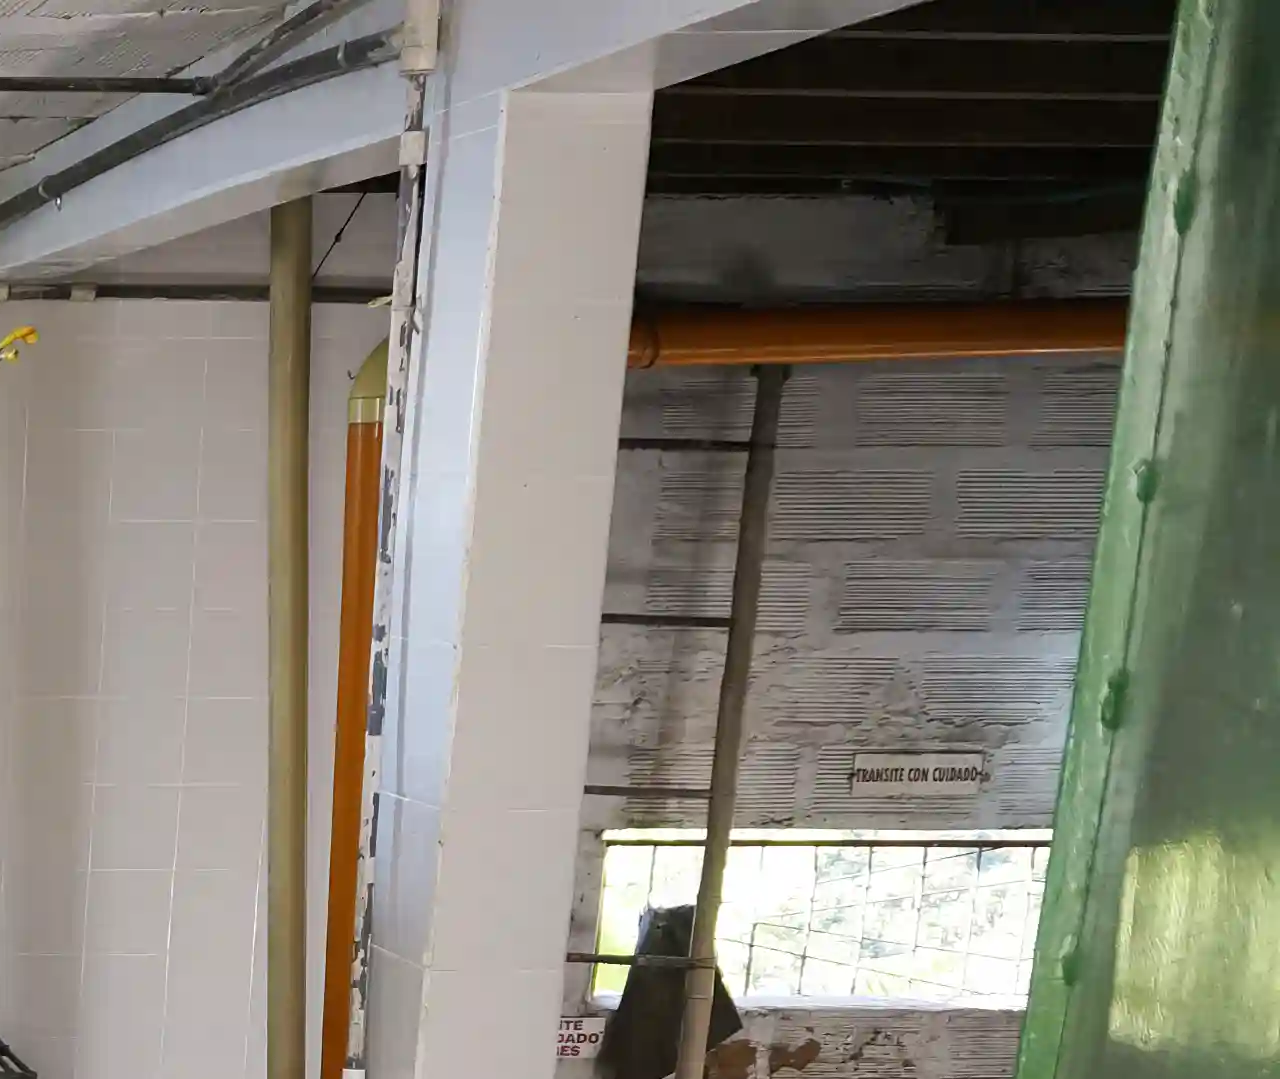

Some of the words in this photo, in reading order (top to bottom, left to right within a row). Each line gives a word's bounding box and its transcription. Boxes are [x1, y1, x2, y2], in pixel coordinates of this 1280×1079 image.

[856, 767, 905, 782] TRANSITE
[908, 767, 930, 782] CON
[932, 766, 978, 782] CUIDADO
